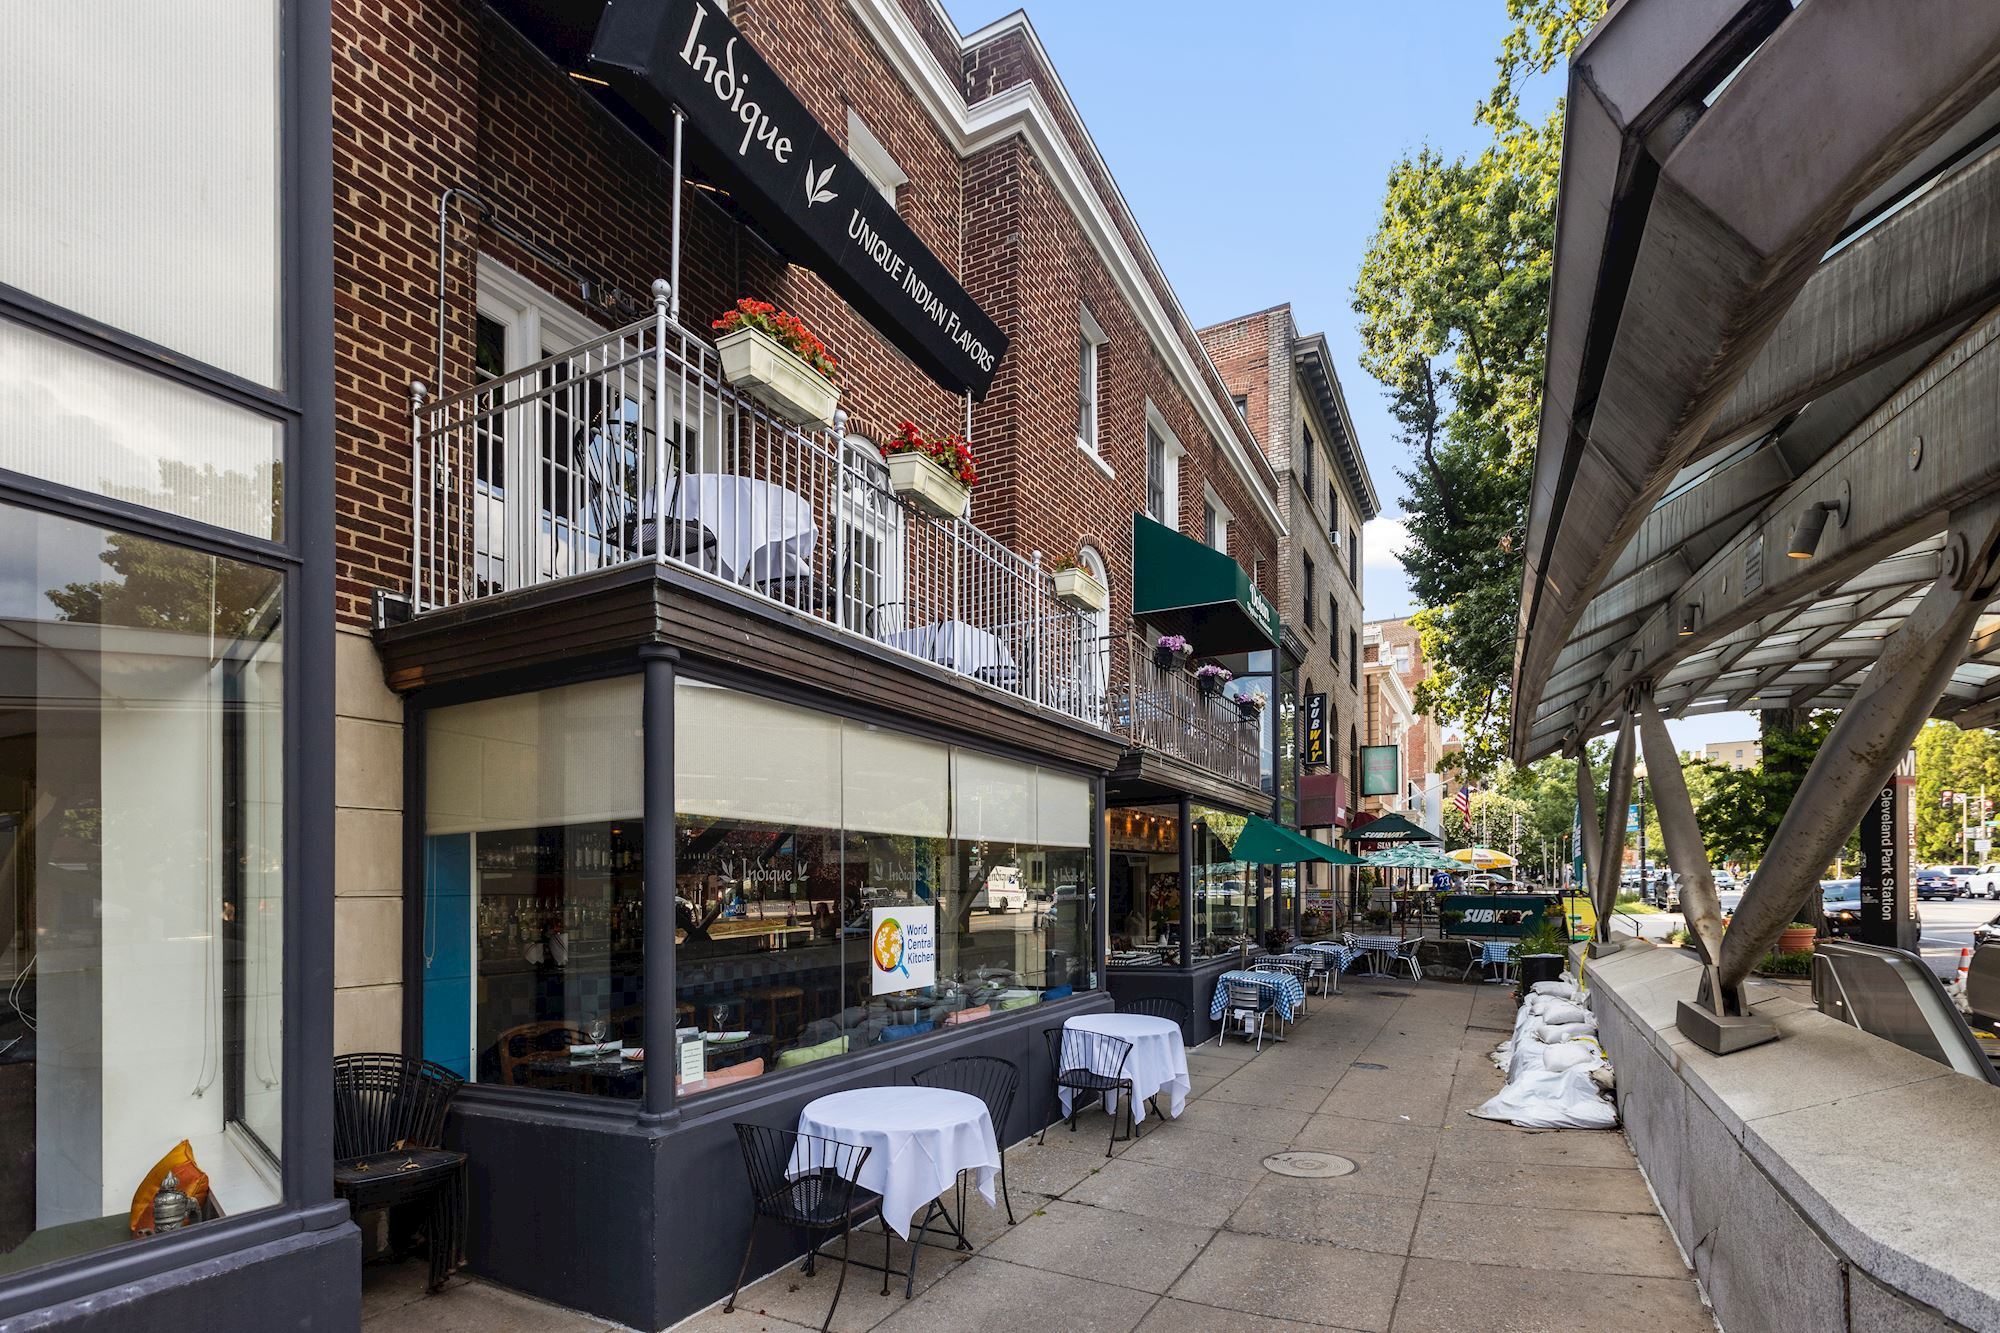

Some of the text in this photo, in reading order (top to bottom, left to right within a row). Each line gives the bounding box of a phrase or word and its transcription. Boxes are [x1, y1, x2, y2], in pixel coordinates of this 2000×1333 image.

[678, 1, 794, 164] Indique
[848, 208, 996, 374] UNIQUE INDIAN FLAVORS
[1309, 697, 1323, 762] SUBWAY
[1896, 749, 1916, 777] M
[1360, 831, 1411, 839] SUBWAY
[1880, 787, 1895, 921] Cleveland Park Station
[1908, 849, 1917, 874] Park
[742, 855, 793, 892] Indique
[1438, 875, 1450, 888] 23
[1908, 876, 1917, 920] Station
[1463, 908, 1534, 924] SUBWY
[906, 923, 928, 936] World
[907, 936, 934, 950] Central
[907, 951, 935, 965] Kitchen
